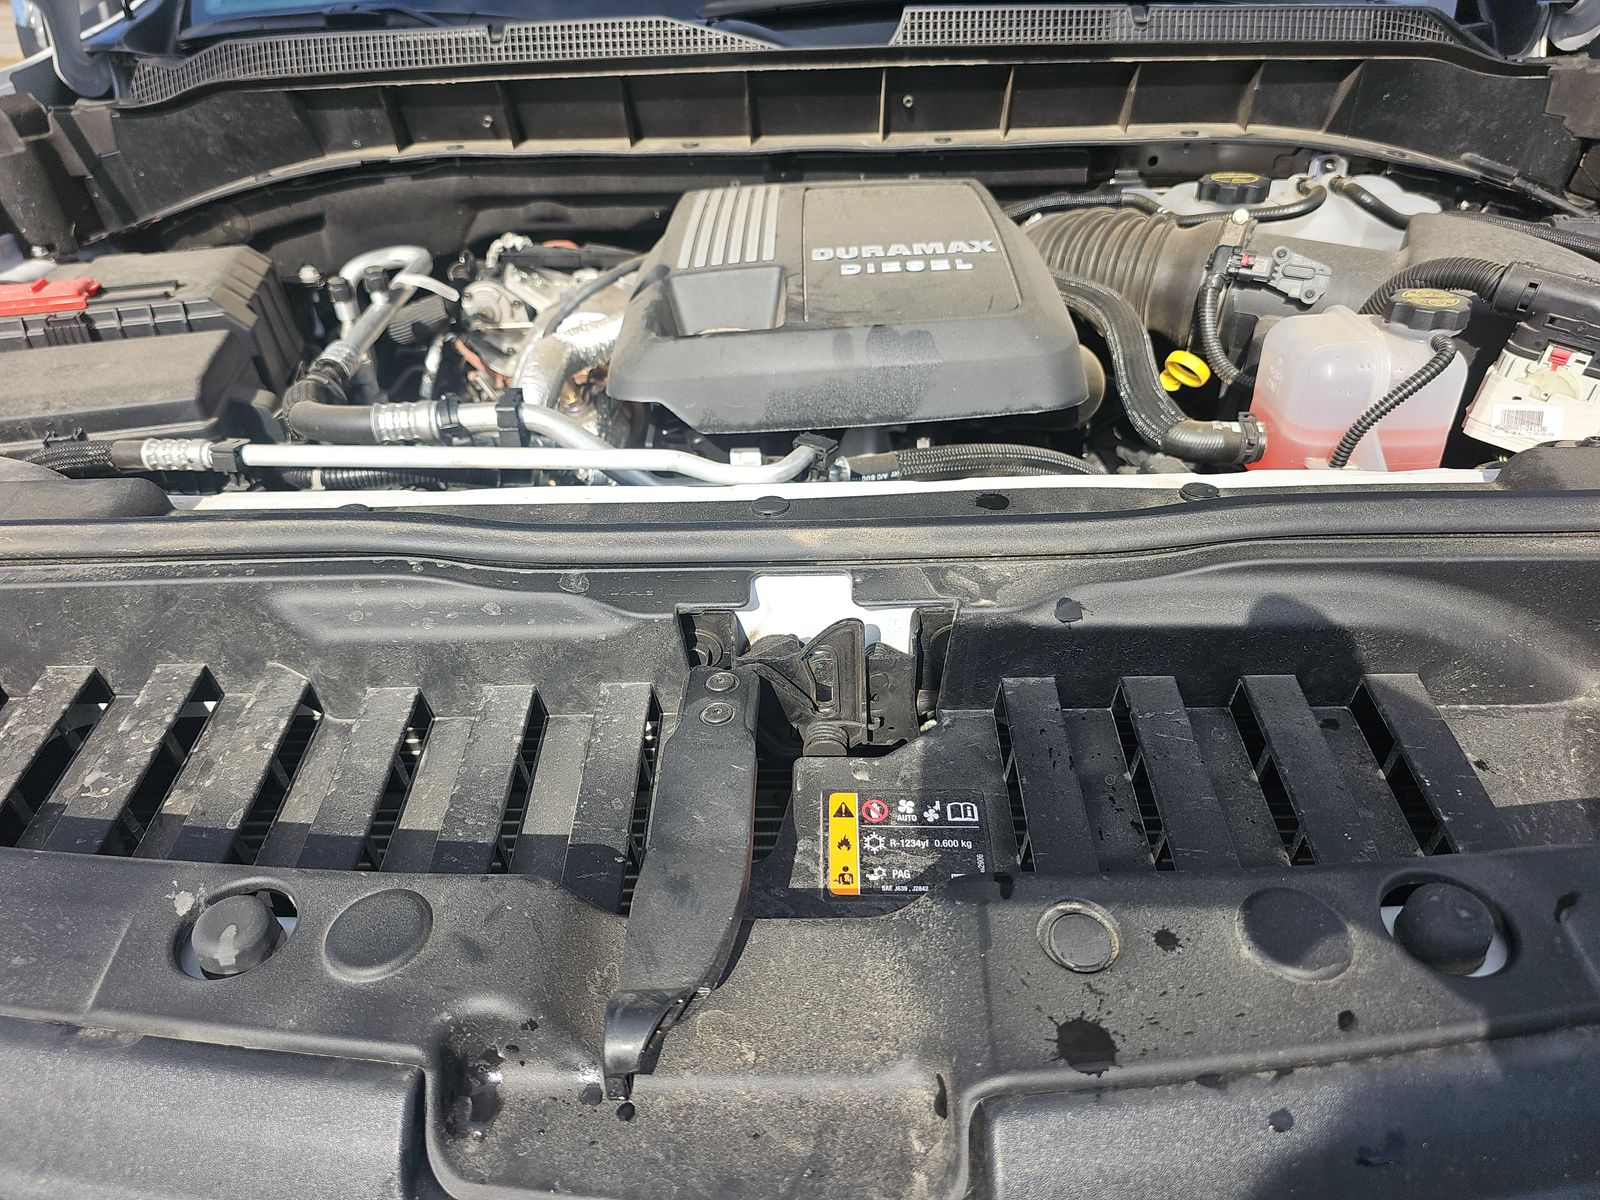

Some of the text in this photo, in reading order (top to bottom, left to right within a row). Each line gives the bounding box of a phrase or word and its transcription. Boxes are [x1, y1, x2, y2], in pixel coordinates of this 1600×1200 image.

[811, 240, 997, 260] DURAMAX
[840, 259, 973, 275] DIESEL
[897, 814, 917, 822] AUTO
[889, 839, 972, 849] R-1234yf 0.600 kg
[892, 869, 911, 879] PAG
